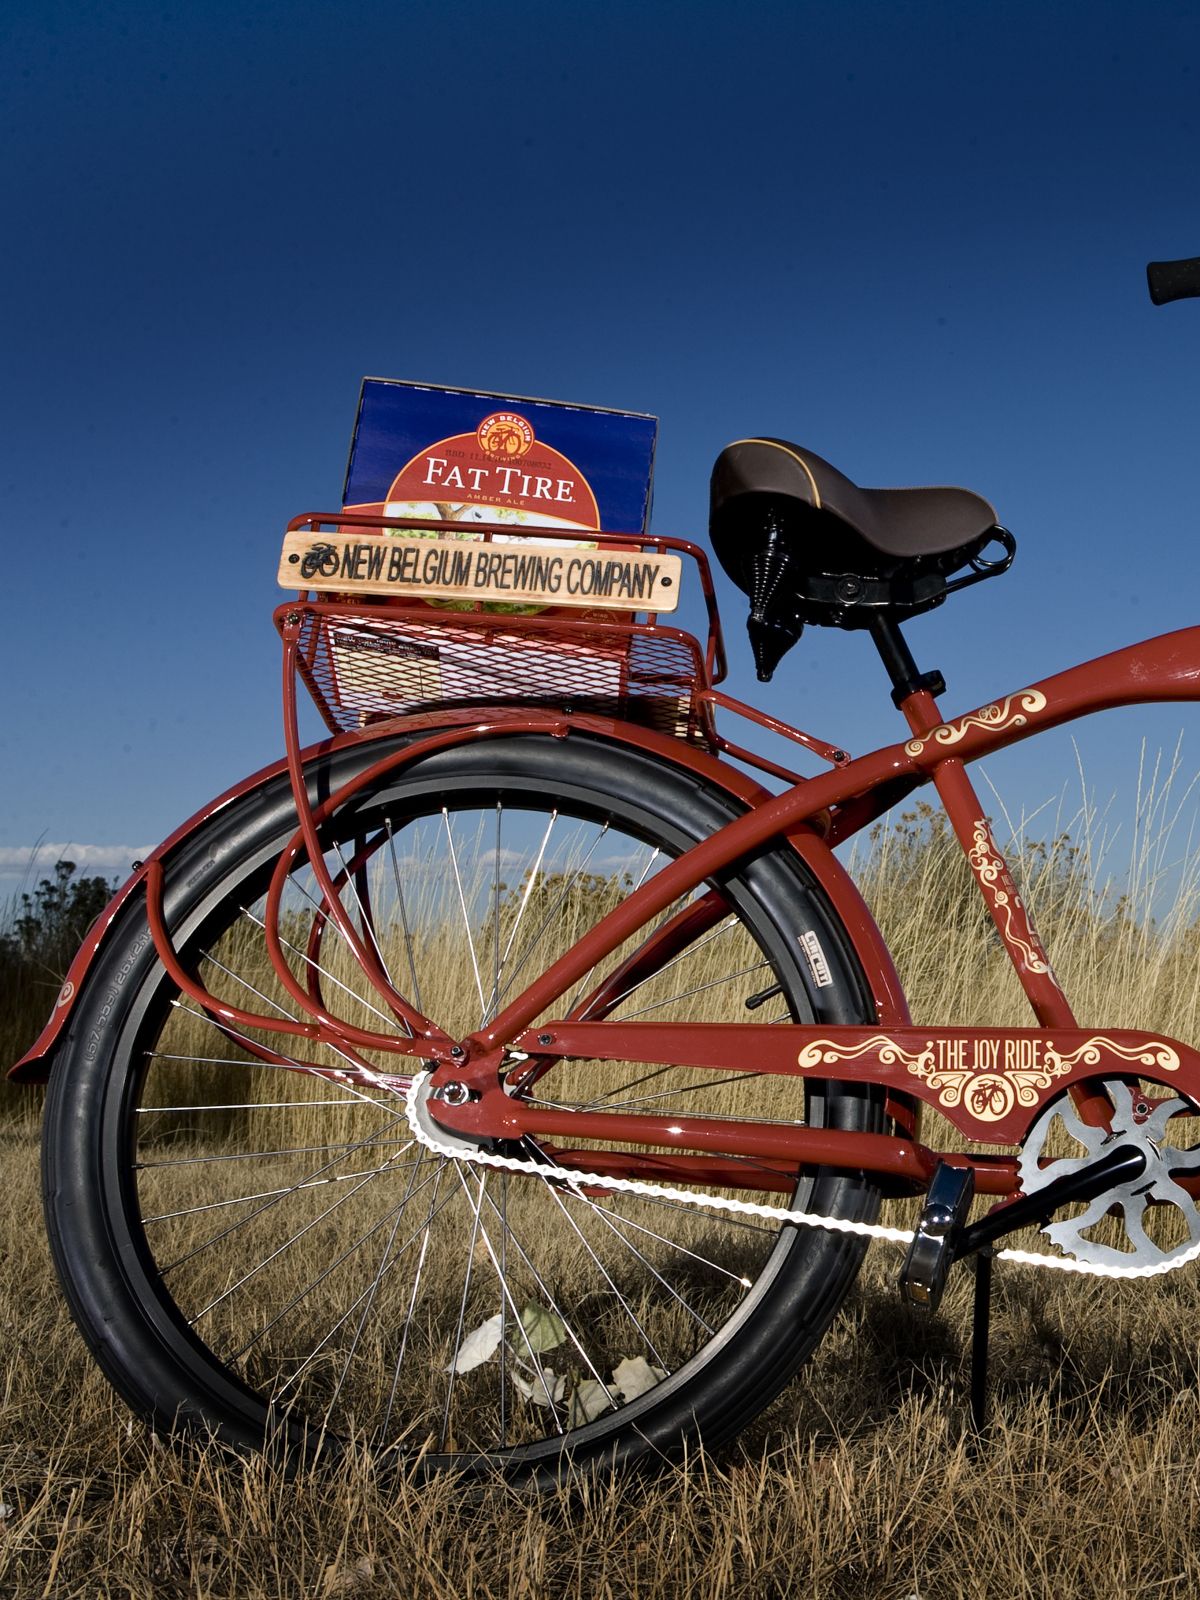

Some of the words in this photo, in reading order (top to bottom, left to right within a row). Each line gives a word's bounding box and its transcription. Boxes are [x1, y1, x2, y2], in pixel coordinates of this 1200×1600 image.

[480, 417, 496, 437] NEW
[499, 415, 532, 442] BELGIUM
[422, 457, 489, 490] FAT
[495, 466, 575, 503] TIRE
[466, 493, 501, 503] AMBER
[506, 498, 526, 506] ALE
[340, 543, 388, 581] NEW
[387, 546, 472, 586] BELGIUM
[474, 551, 563, 593] BREWING
[566, 558, 660, 599] COMPANY
[803, 930, 833, 988] CIRCUIT
[936, 1039, 968, 1069] THE
[972, 1039, 1000, 1069] JOY
[1004, 1039, 1042, 1069] RIDE
